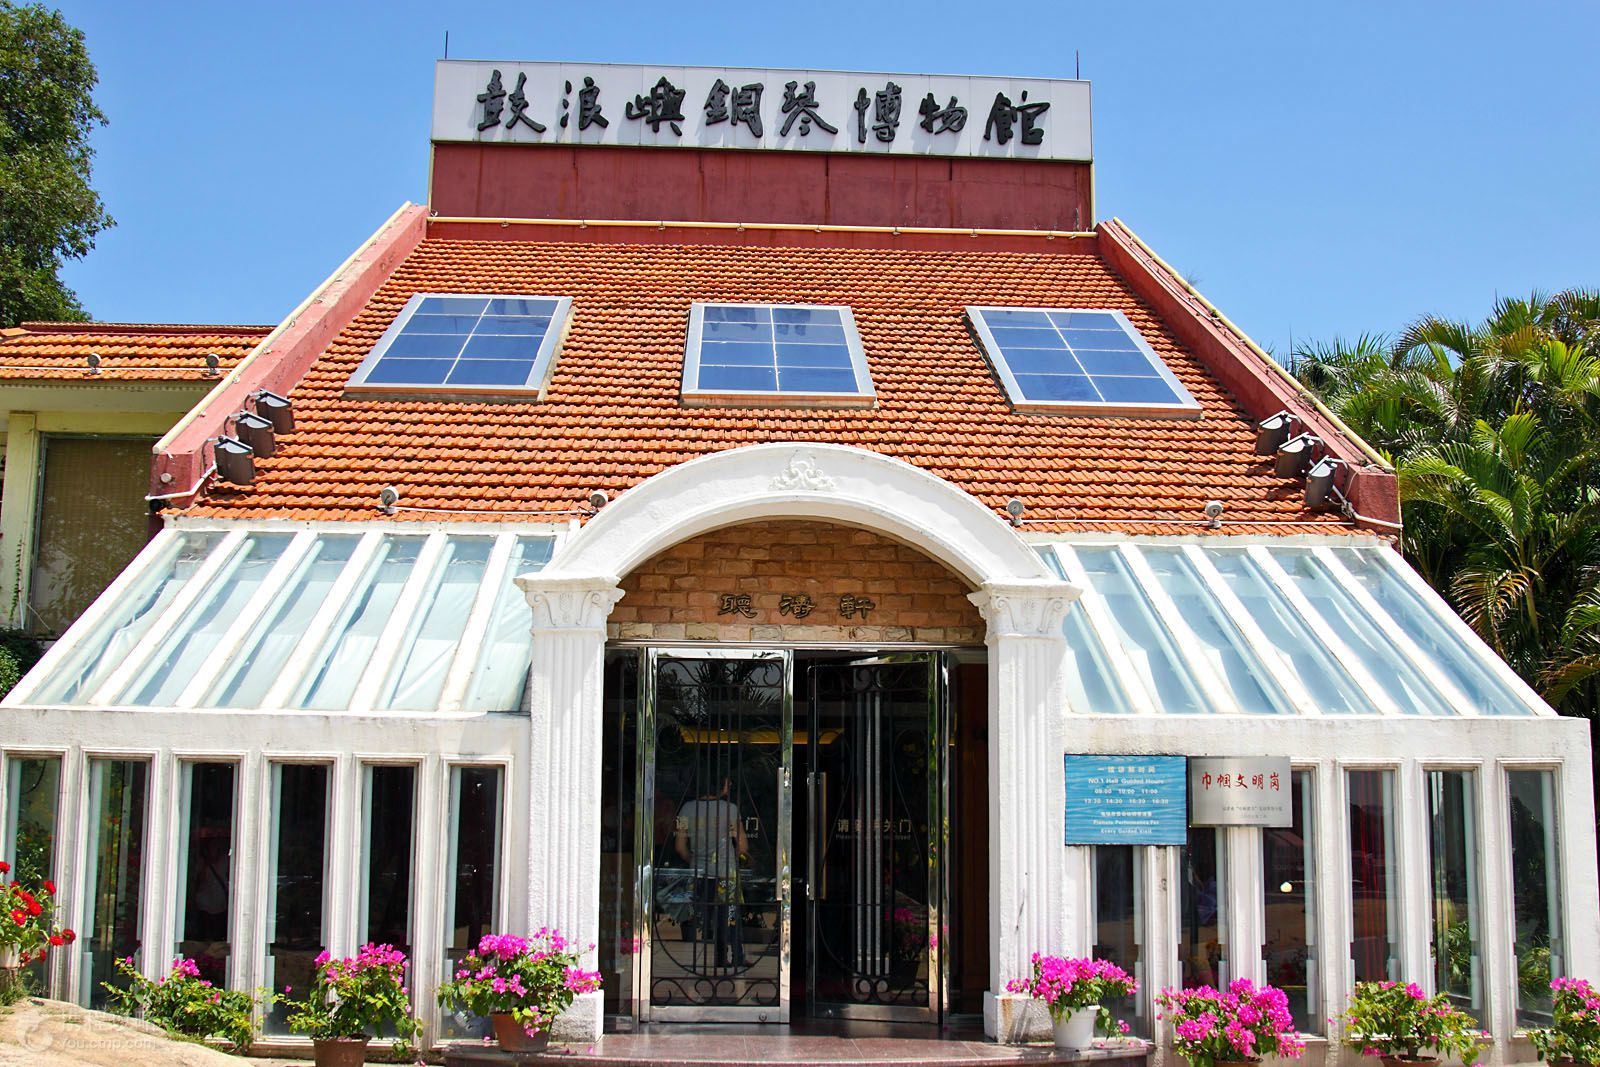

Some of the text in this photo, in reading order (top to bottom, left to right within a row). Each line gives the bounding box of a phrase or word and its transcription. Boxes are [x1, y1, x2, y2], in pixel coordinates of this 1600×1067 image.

[1201, 771, 1280, 792] 巾帼文明岗
[837, 818, 912, 833] 请关门
